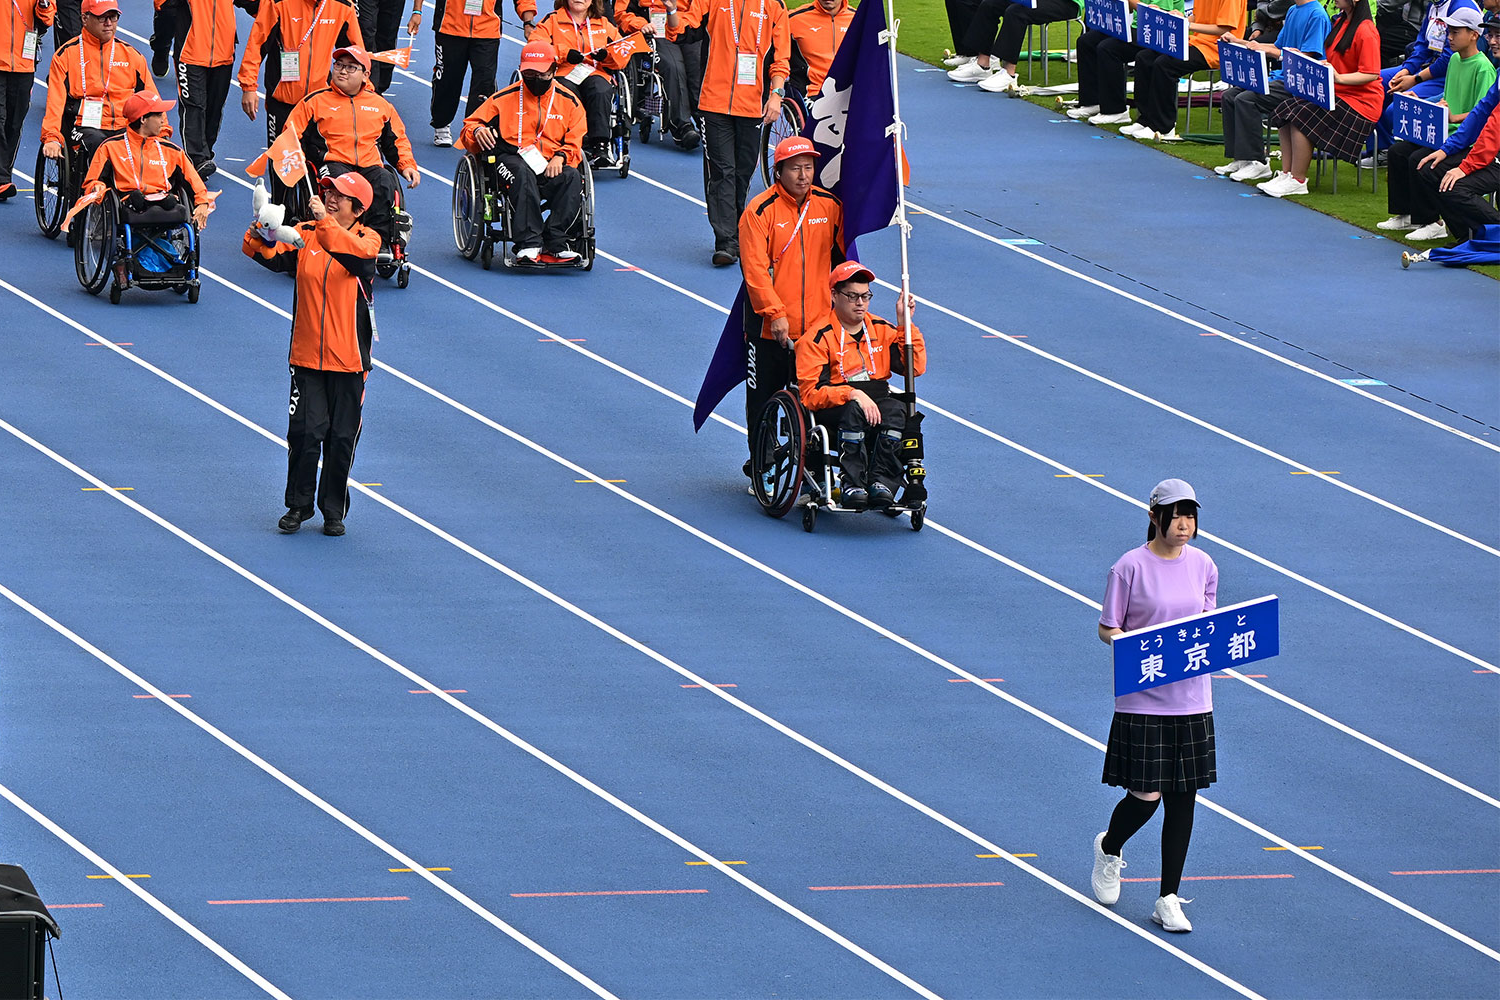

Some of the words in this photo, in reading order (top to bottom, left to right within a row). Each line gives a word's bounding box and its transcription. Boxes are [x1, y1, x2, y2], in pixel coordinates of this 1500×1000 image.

[1088, 6, 1122, 35] 北九州市
[1144, 11, 1177, 30] かがわけん
[1143, 24, 1177, 53] 香川県
[1225, 60, 1257, 88] 岡山県
[1288, 55, 1325, 79] わかやまけん
[1287, 69, 1325, 103] 和歌山県
[1400, 100, 1434, 119] おおさかふ
[1400, 114, 1436, 145] 大阪府
[788, 144, 811, 152] TOKYO
[807, 217, 828, 225] TOKYO
[747, 341, 757, 390] TOKYO
[1140, 614, 1247, 651] とうきょうと
[1138, 630, 1257, 684] 東京都
